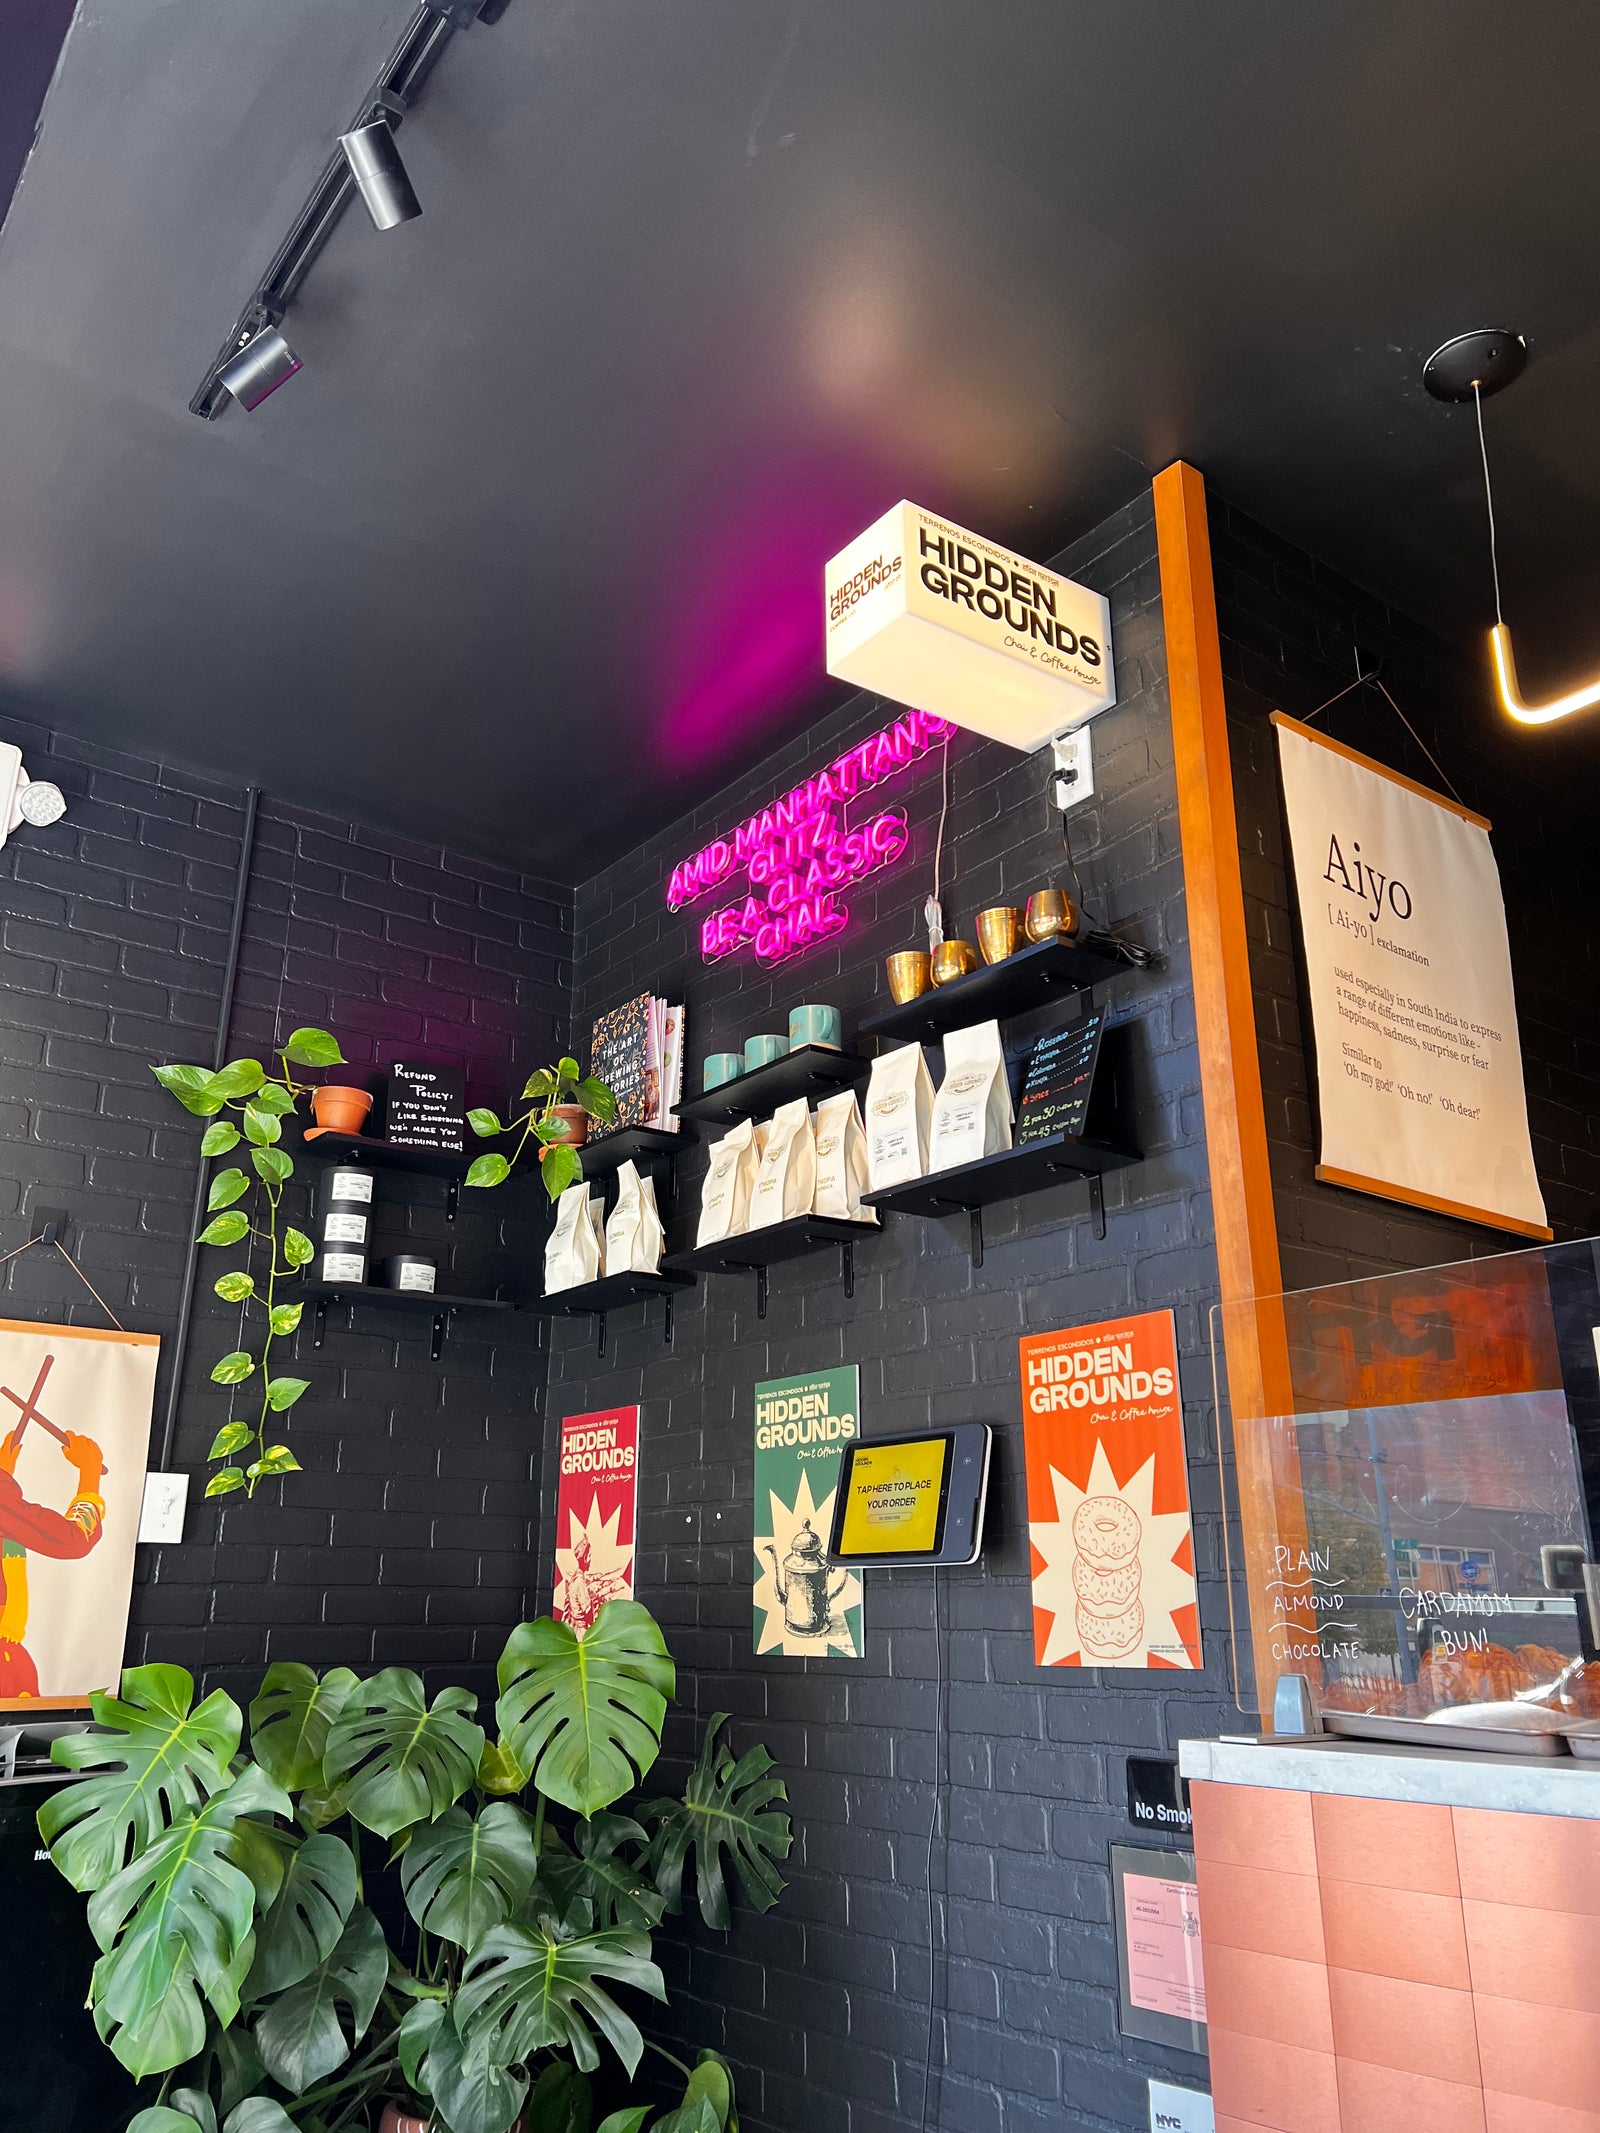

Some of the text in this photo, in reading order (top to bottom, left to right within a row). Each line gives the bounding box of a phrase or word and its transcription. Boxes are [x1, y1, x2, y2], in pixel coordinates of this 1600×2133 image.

[918, 513, 1011, 563] TERRENOS ESCONDIDOS
[830, 554, 882, 608] HIDDEN
[919, 527, 1058, 618] HIDDEN
[831, 556, 902, 621] GROUNDS
[920, 563, 1101, 667] GROUNDS
[1004, 636, 1028, 652] Chai
[667, 840, 736, 904] AMID
[701, 814, 907, 955] BE A CLASSIC
[1323, 833, 1412, 921] Aiyo
[1377, 936, 1430, 967] exclamation
[1334, 966, 1502, 1042] used especially in South India to express
[1336, 985, 1342, 996] a
[1343, 989, 1366, 1009] range
[1368, 1000, 1377, 1013] of
[1377, 1006, 1415, 1029] different
[1417, 1022, 1458, 1044] emotions
[1458, 1032, 1476, 1049] like
[602, 1033, 638, 1060] THE ART
[1337, 1001, 1490, 1071] happiness, sadness, surprise or fear
[613, 1053, 625, 1067] OF
[1341, 1042, 1382, 1070] Similar to
[1360, 1071, 1374, 1088] my
[391, 1100, 447, 1112] IF YOU DON'T
[397, 1112, 464, 1125] LIKE SOMETHING
[1022, 1115, 1030, 1128] 2
[1042, 1105, 1056, 1120] 30
[390, 1135, 463, 1152] SOMETHING ELSE!
[412, 1126, 436, 1134] MAKE
[440, 1127, 457, 1136] YOU
[1019, 1131, 1027, 1145] 3
[1028, 1343, 1133, 1386] HIDDEN
[1030, 1367, 1174, 1414] GROUNDS
[756, 1392, 829, 1426] HIDDEN
[562, 1427, 617, 1455] HIDDEN
[756, 1413, 856, 1450] GROUNDS
[561, 1446, 635, 1475] GROUNDS
[857, 1479, 932, 1495] TAP HERE TO PLACE
[867, 1497, 917, 1509] YOUR ORDER
[1274, 1545, 1330, 1573] PLAIN
[1273, 1594, 1345, 1615] ALMOND
[1272, 1642, 1360, 1661] CHOCOLATE
[1135, 1801, 1193, 1825] No Smok
[1156, 2113, 1182, 2130] NYC
